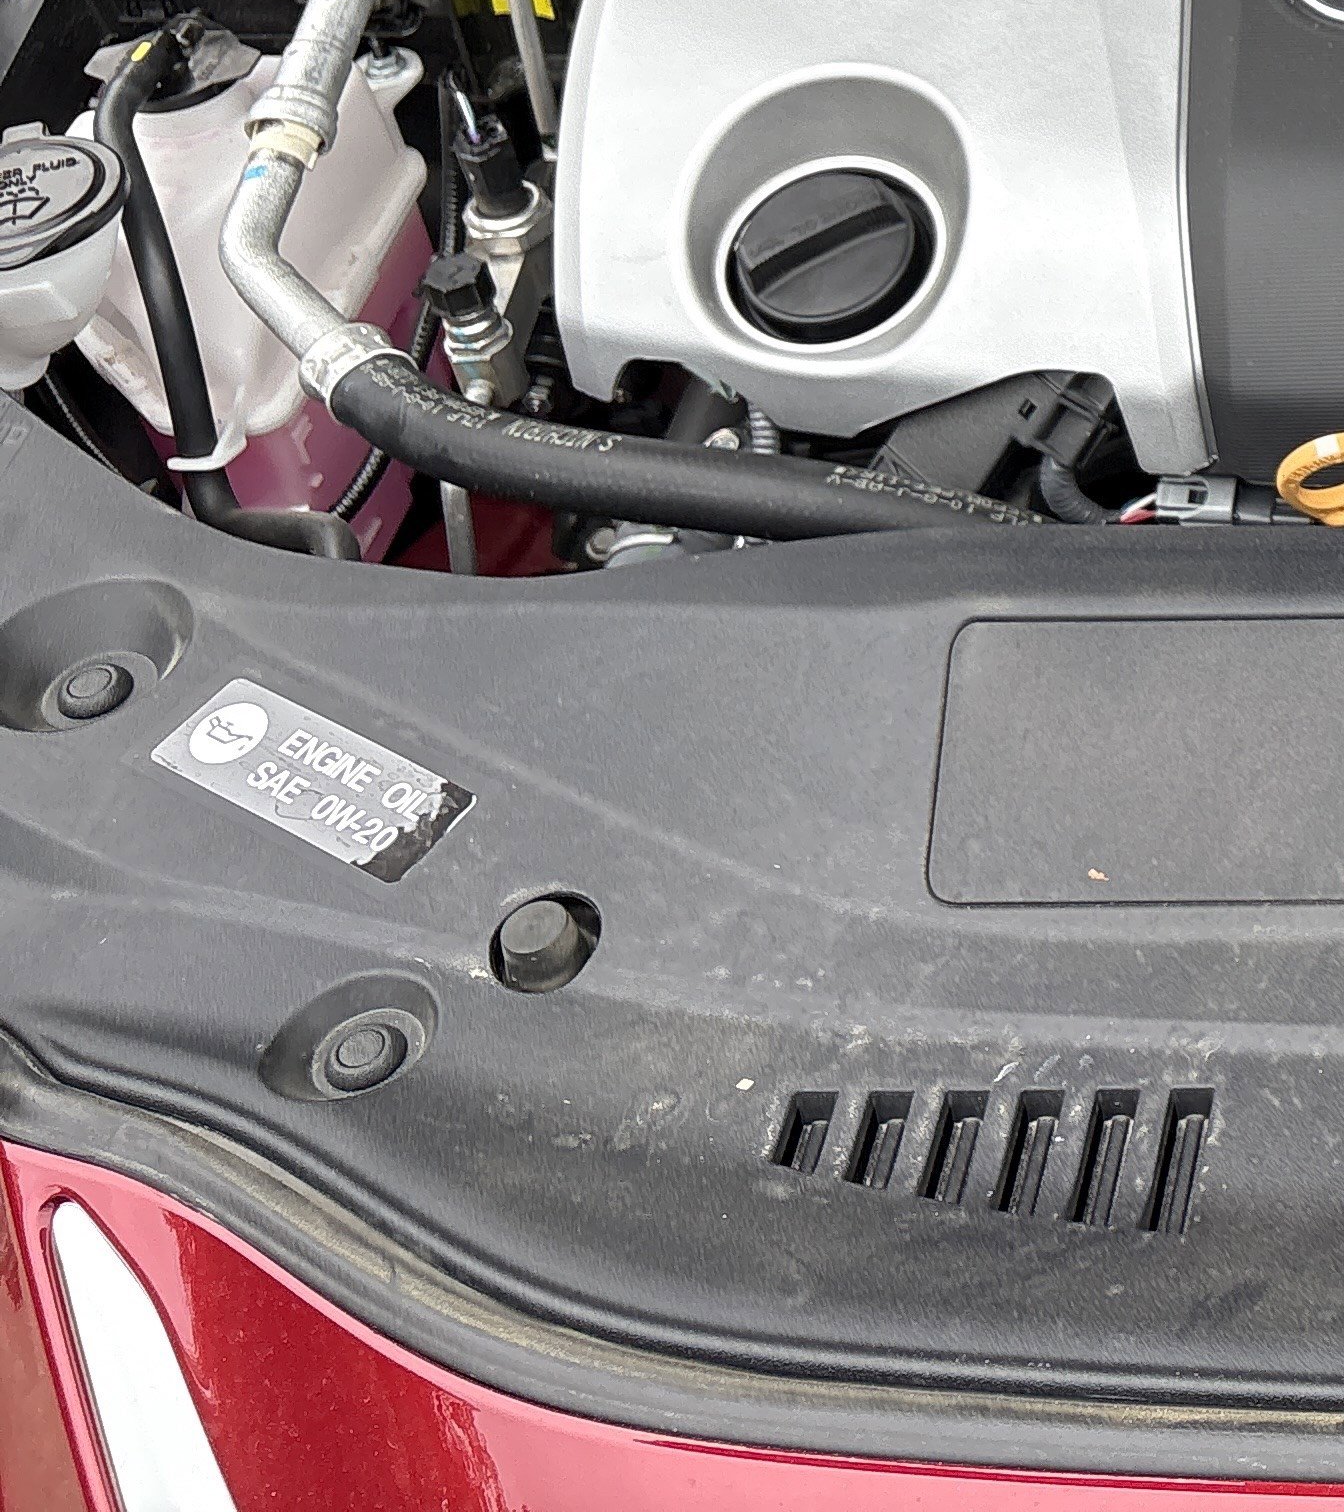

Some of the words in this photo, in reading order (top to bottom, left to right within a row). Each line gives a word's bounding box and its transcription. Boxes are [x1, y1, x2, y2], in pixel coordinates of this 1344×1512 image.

[246, 761, 311, 804] SAE
[311, 794, 399, 852] 0W-20
[277, 728, 381, 793] ENGINE
[381, 782, 428, 823] OIL
